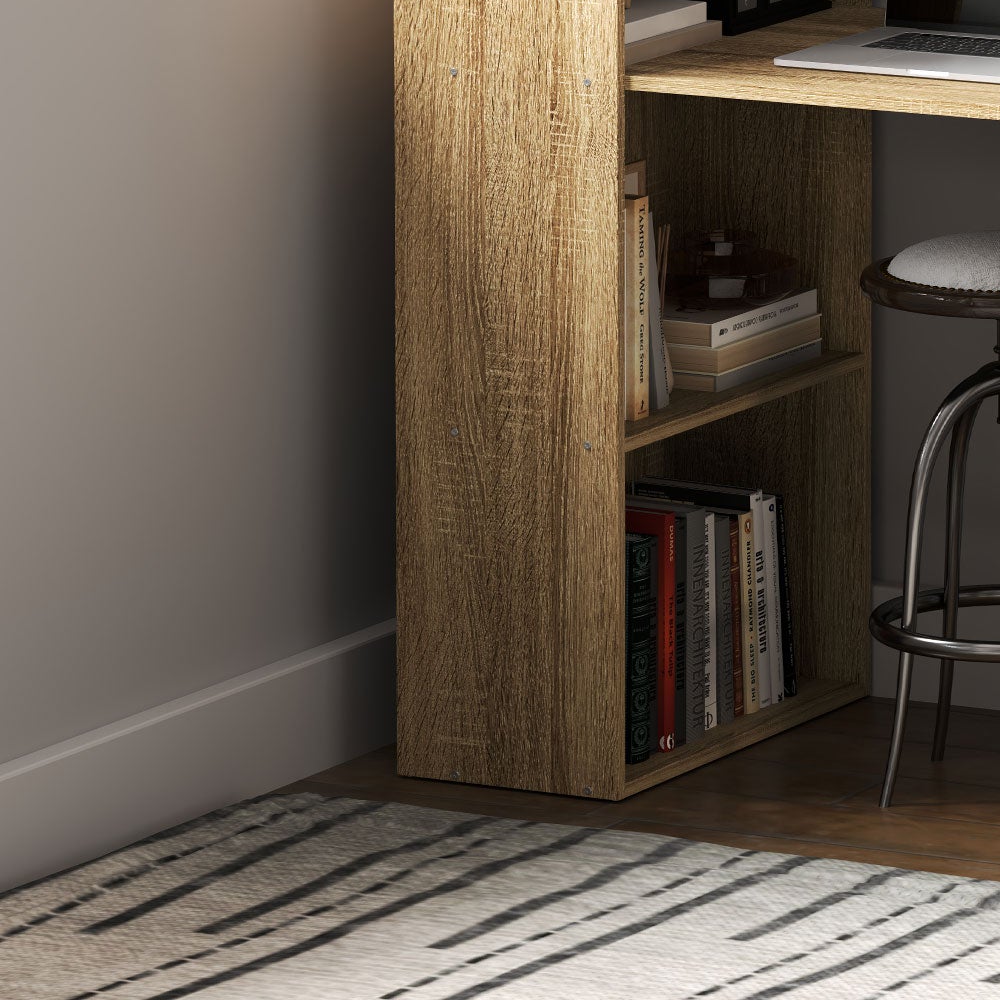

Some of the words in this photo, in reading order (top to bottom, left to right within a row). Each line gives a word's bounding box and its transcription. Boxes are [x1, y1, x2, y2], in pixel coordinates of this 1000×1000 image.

[638, 204, 646, 258] TAMING
[638, 262, 646, 276] the
[756, 550, 764, 572] arts
[692, 544, 705, 728] INNENARCHITEKTUR
[721, 549, 733, 712] INNENARCHITEKTUR
[757, 589, 767, 654] architecture
